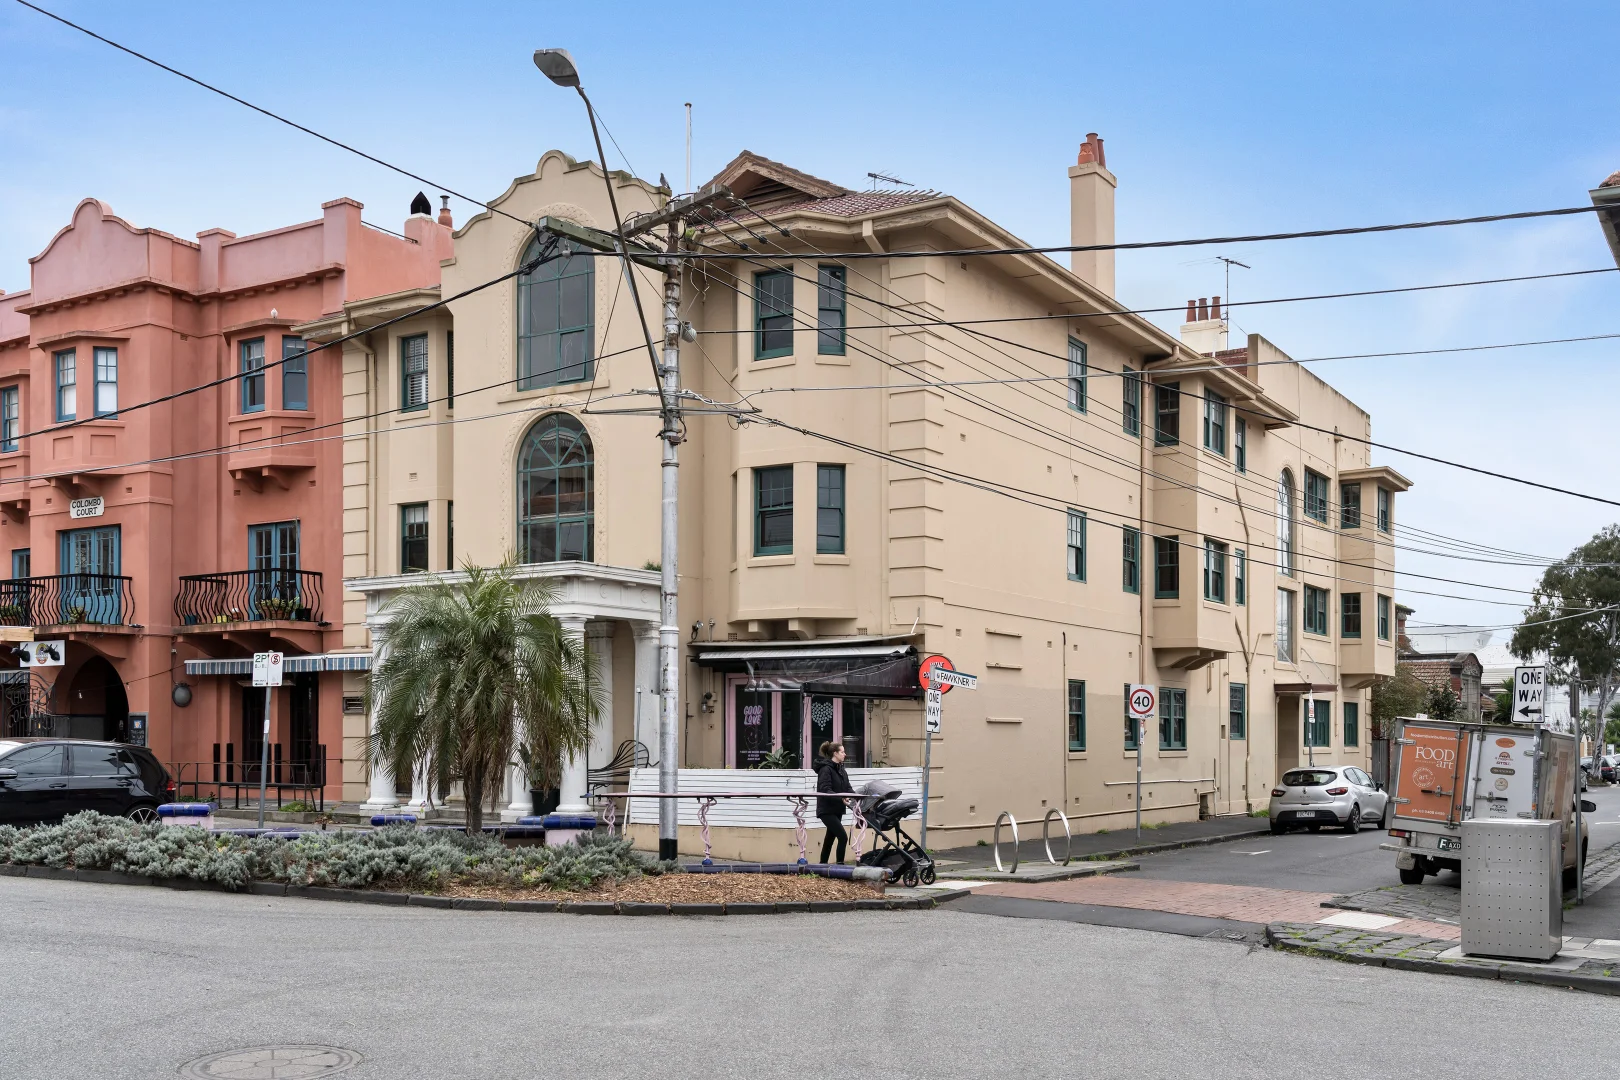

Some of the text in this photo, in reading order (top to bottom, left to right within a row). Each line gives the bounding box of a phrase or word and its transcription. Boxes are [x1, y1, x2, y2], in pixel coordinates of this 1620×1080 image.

[72, 498, 101, 508] COLOMBO
[76, 507, 97, 516] COURT
[255, 654, 267, 663] 2P
[940, 672, 970, 687] FAWKNER
[1521, 672, 1542, 684] ONE
[928, 692, 940, 704] ONE
[1133, 695, 1150, 708] 40
[1518, 689, 1542, 702] WAY
[743, 704, 764, 715] GOOD
[927, 705, 940, 717] WAY
[743, 714, 763, 726] LOVE
[1415, 746, 1455, 762] FOOD
[1435, 760, 1454, 770] art
